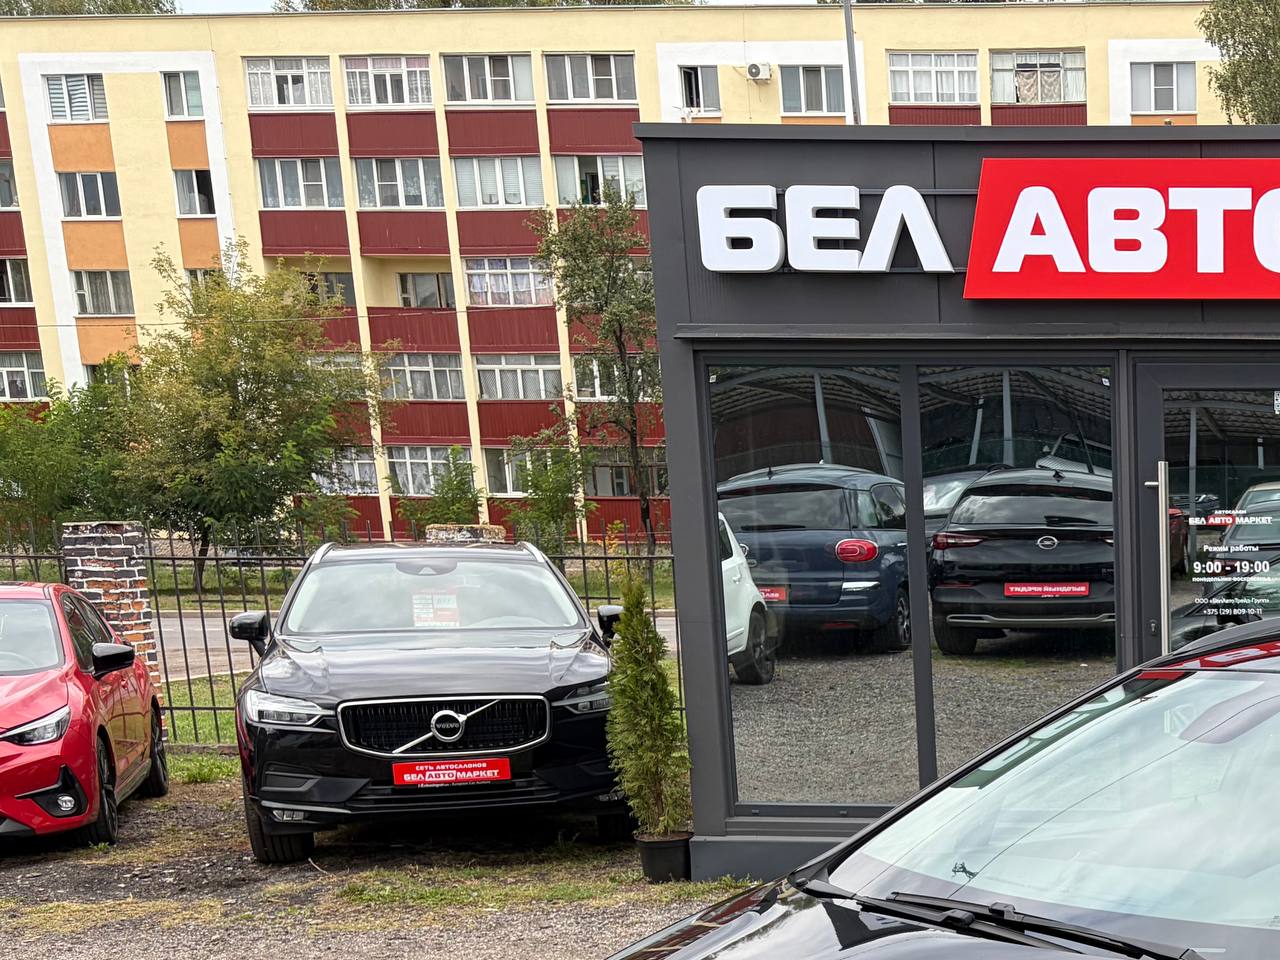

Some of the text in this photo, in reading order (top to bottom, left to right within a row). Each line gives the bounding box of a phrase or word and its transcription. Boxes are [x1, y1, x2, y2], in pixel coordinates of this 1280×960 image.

[696, 185, 954, 274] БЕЛ
[1230, 544, 1259, 553] работы
[1193, 561, 1222, 573] 9:00
[1234, 561, 1270, 573] 19:00
[436, 762, 487, 771] АВТОСАЛОНОВ
[403, 769, 500, 781] БЕЛ АВТО МАРКЕТ
